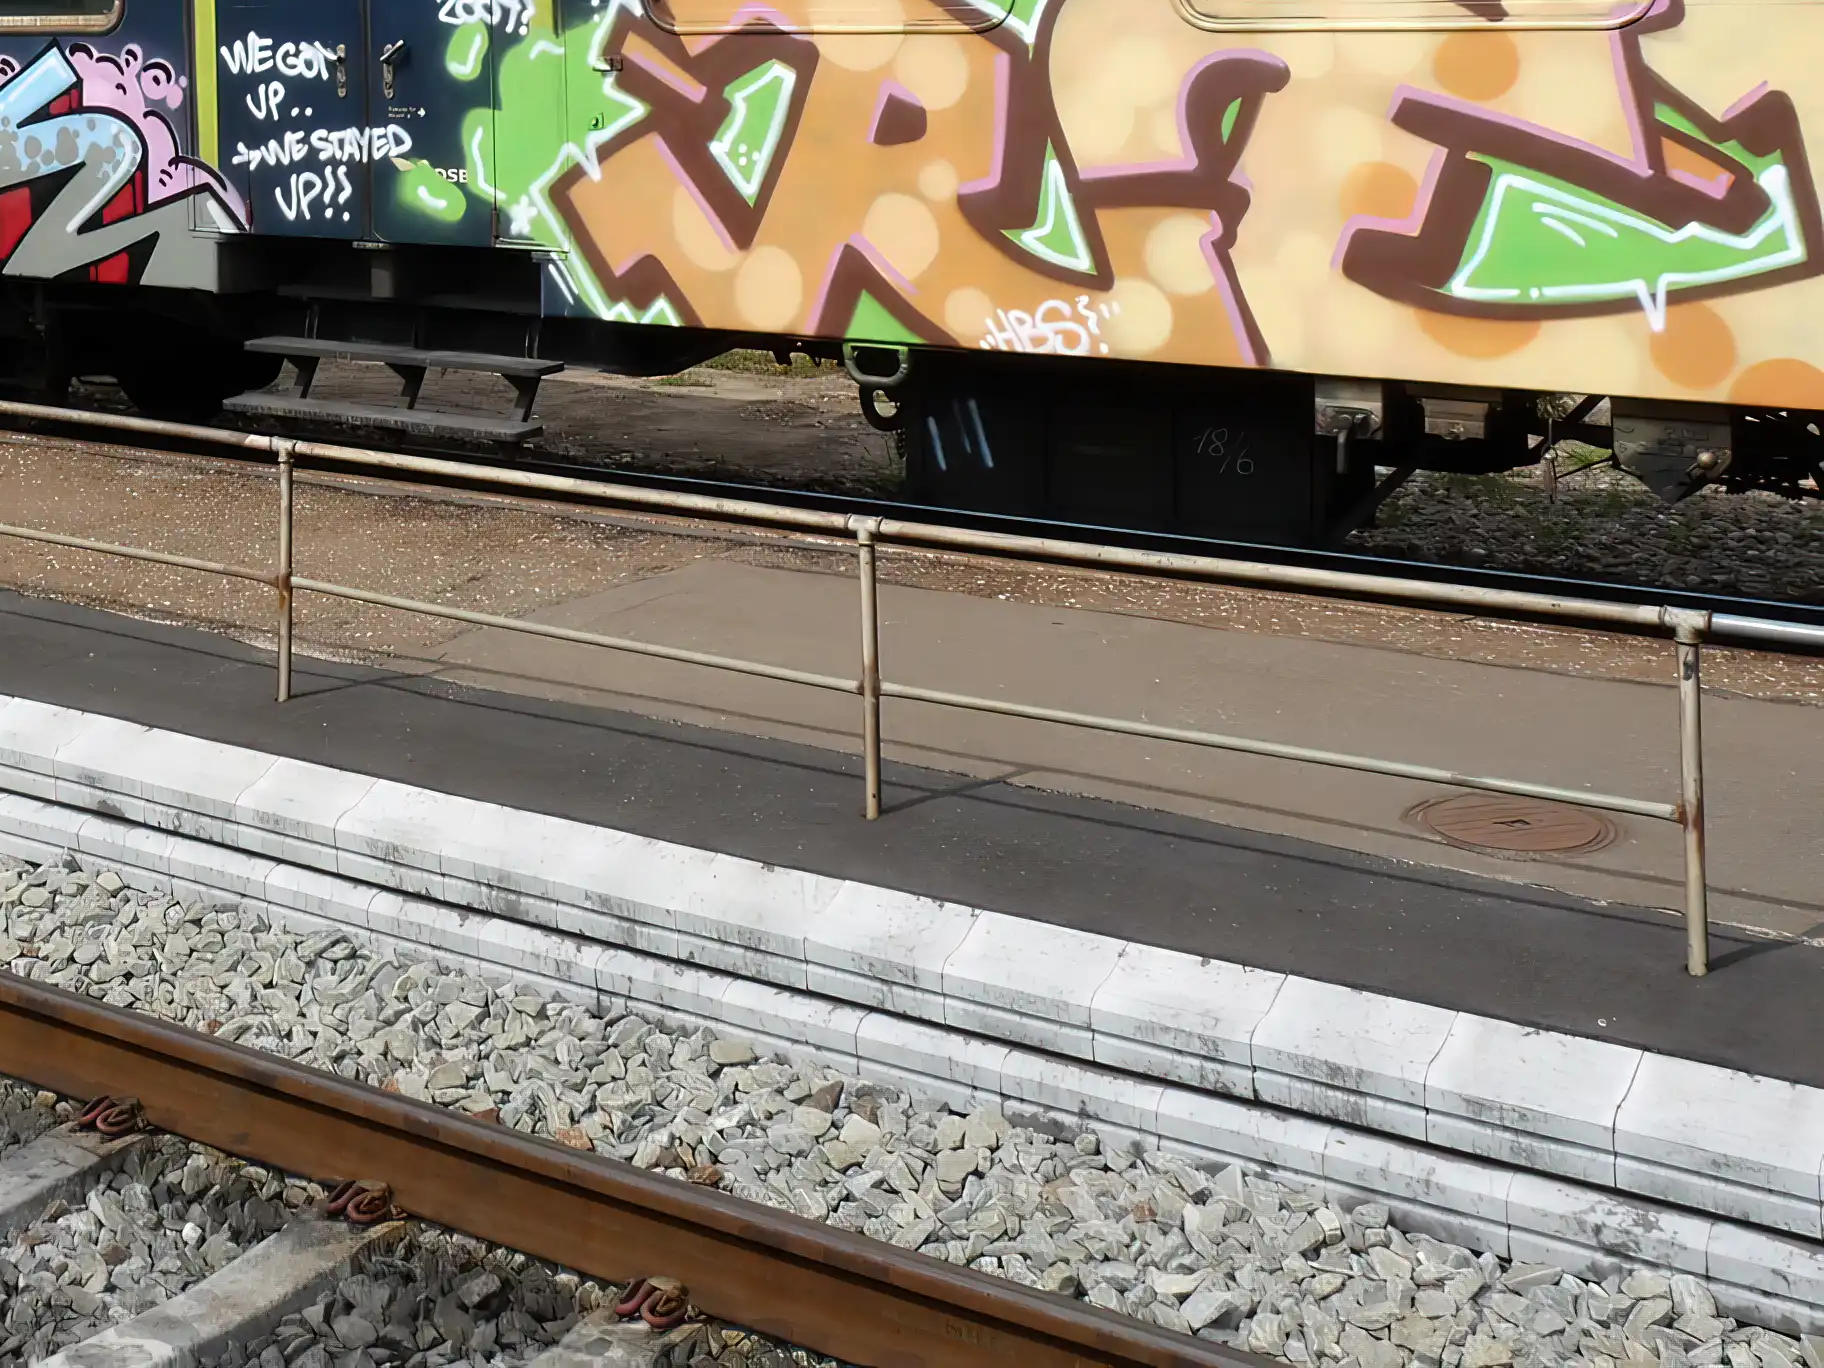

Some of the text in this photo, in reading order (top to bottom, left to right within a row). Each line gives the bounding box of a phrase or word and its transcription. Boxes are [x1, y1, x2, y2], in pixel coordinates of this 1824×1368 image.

[220, 30, 331, 81] WE GOT
[259, 123, 413, 166] WE STAYED
